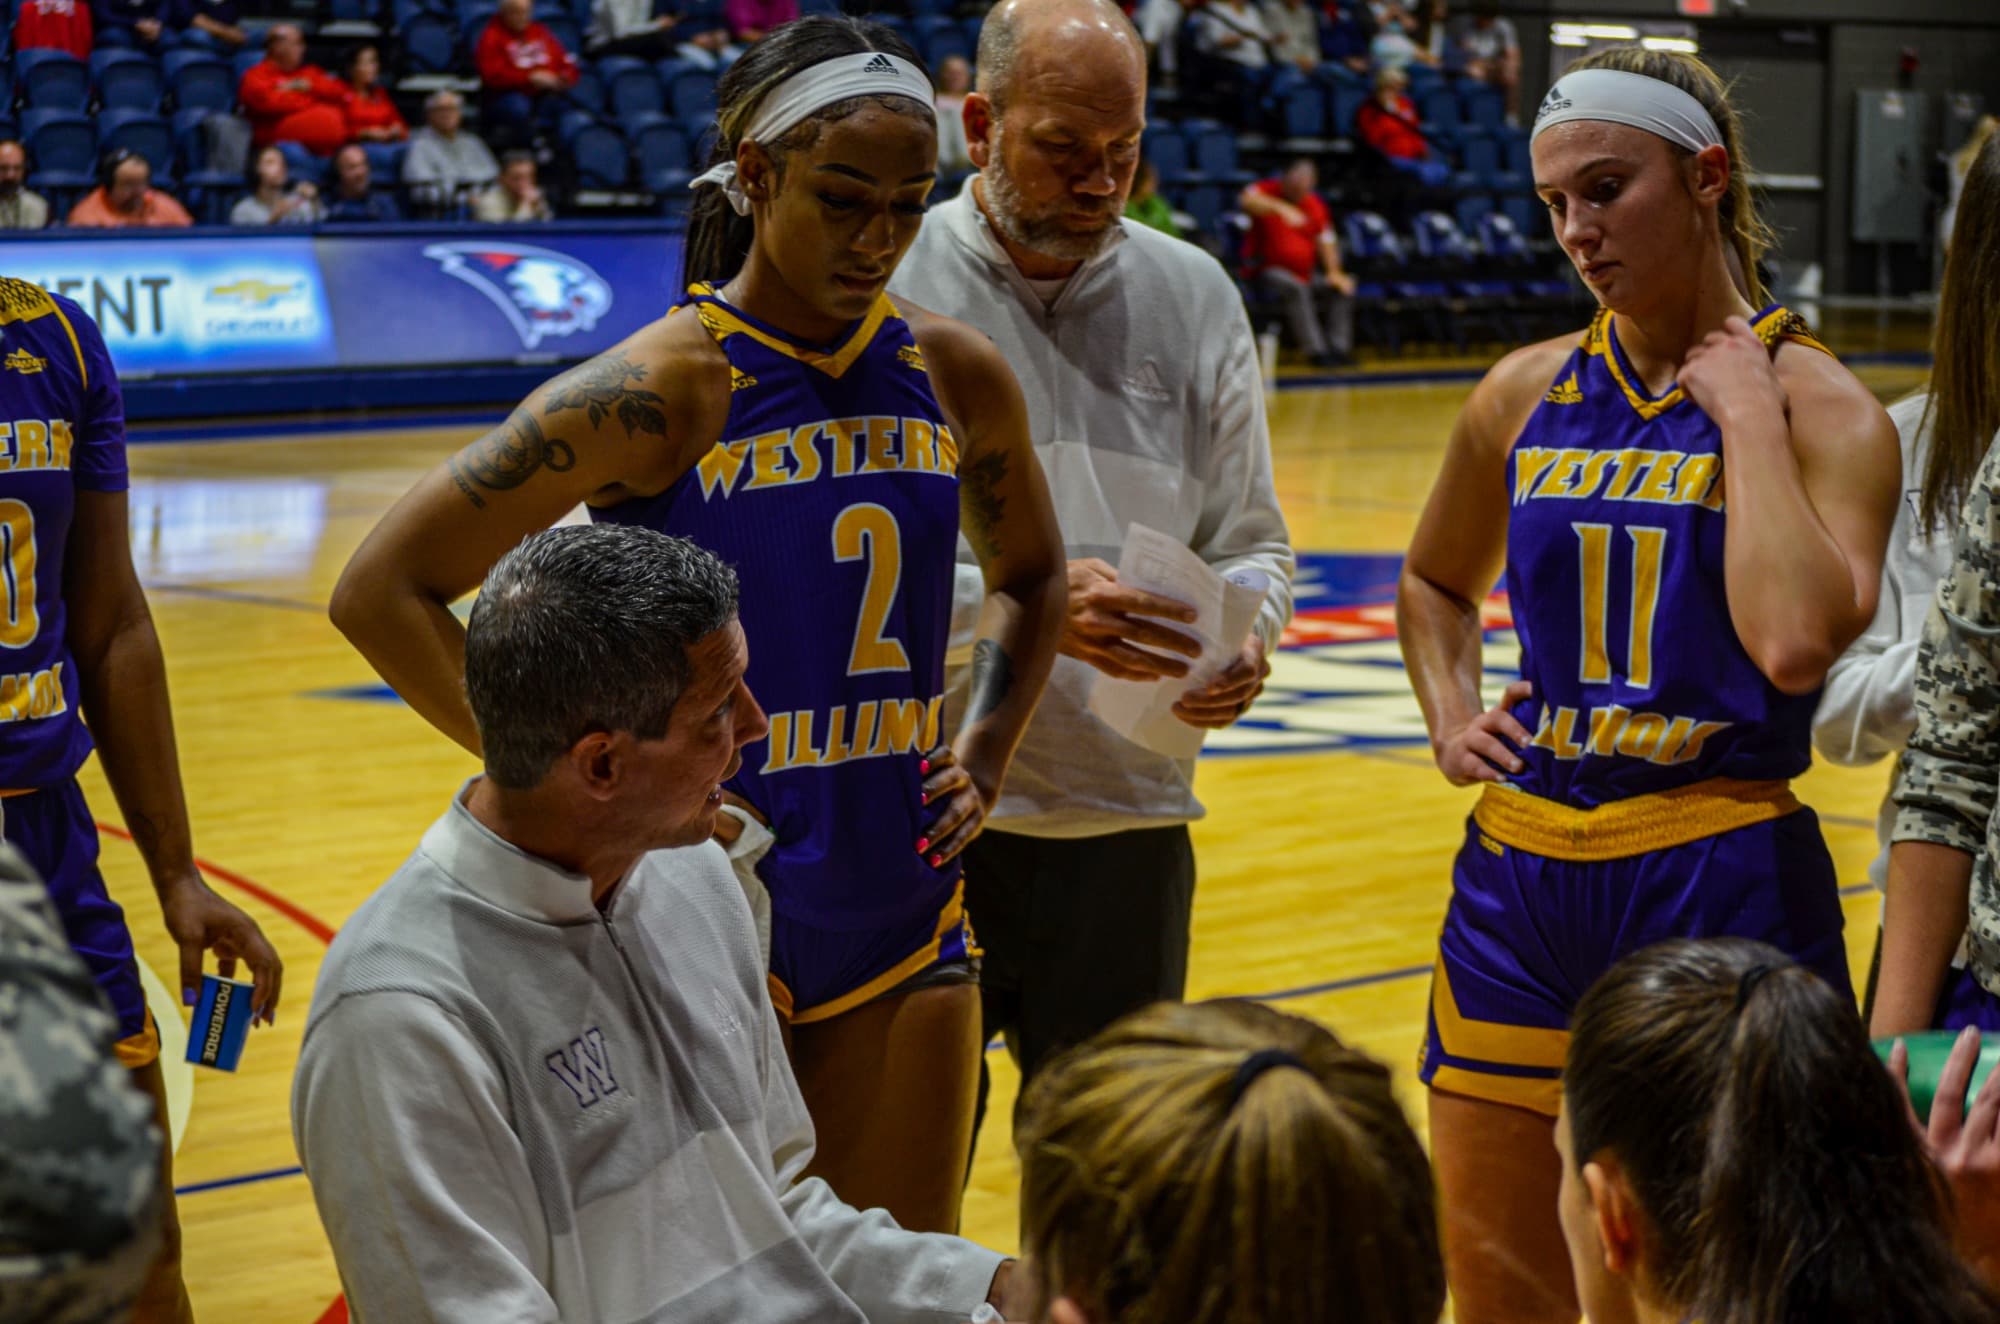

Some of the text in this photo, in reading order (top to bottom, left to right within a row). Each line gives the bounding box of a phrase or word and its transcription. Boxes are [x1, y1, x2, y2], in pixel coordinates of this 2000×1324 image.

[863, 65, 900, 75] adidas
[1513, 446, 1729, 512] WESTER
[831, 502, 911, 676] 2
[1570, 521, 1667, 688] 11
[202, 982, 234, 1063] POWERADE
[544, 1026, 619, 1108] W
